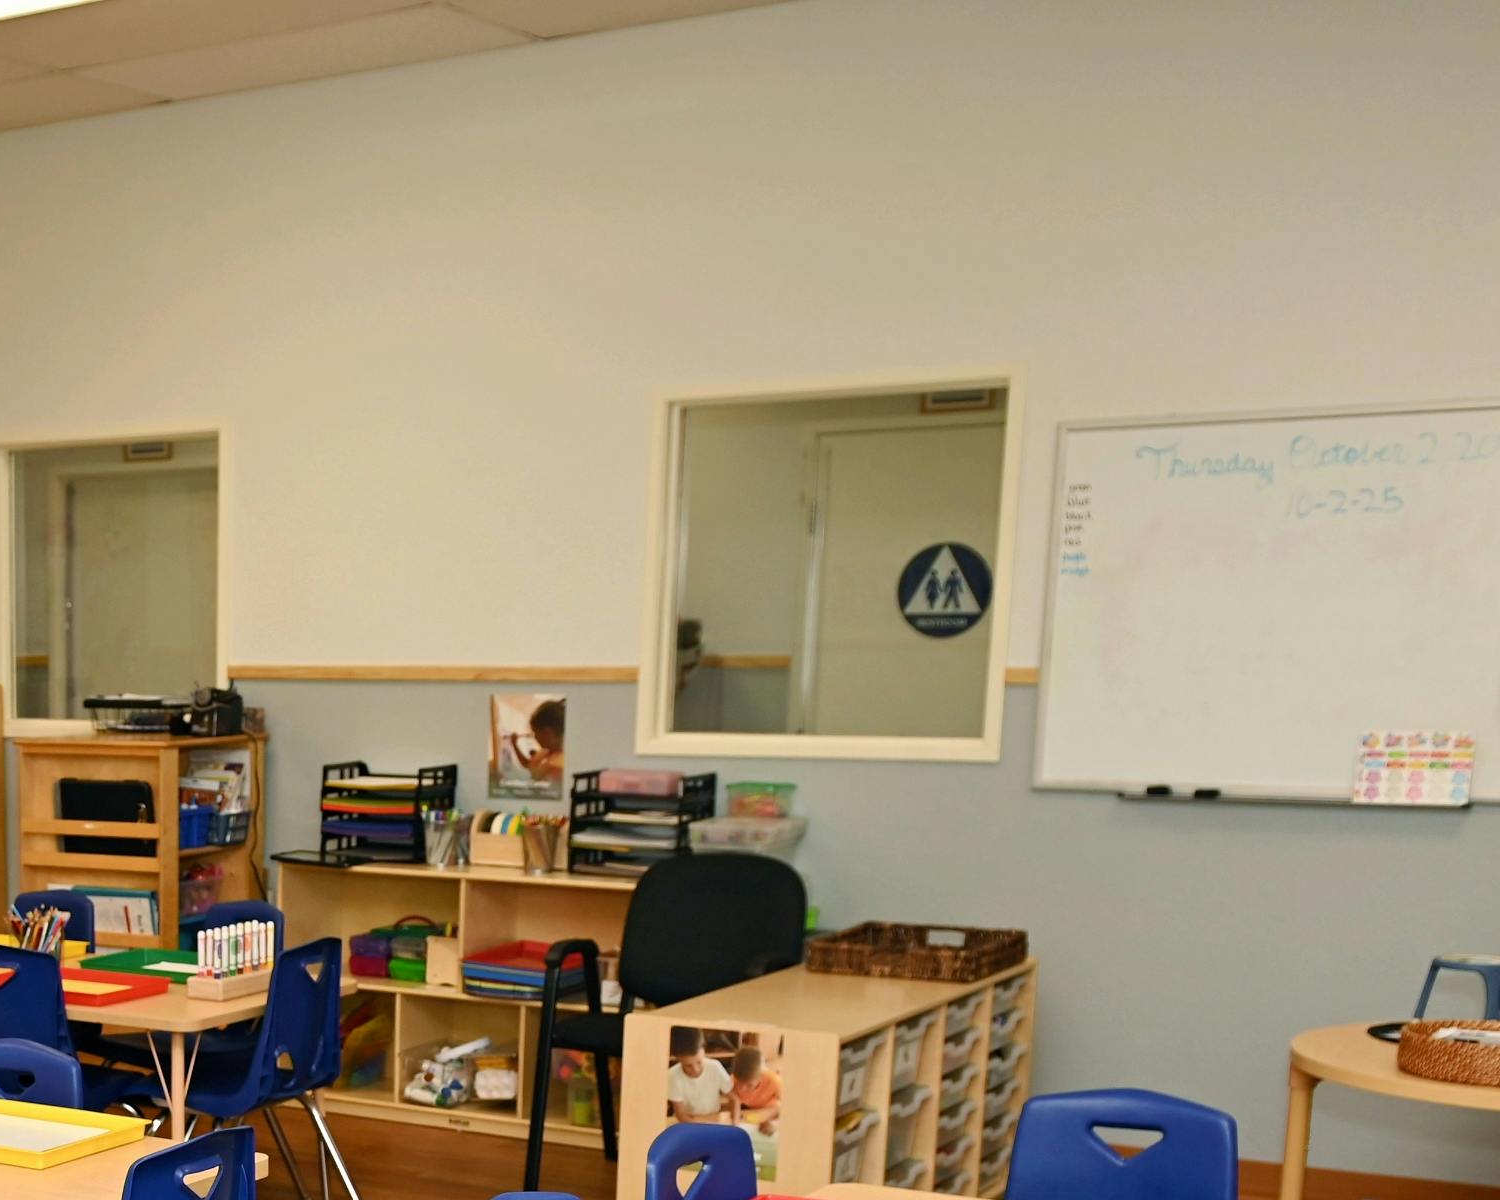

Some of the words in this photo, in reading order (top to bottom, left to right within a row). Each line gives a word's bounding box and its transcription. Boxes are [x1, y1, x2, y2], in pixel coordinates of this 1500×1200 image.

[1135, 441, 1275, 484] Thursday
[1289, 434, 1406, 471] October
[1286, 486, 1405, 519] 10-2-25
